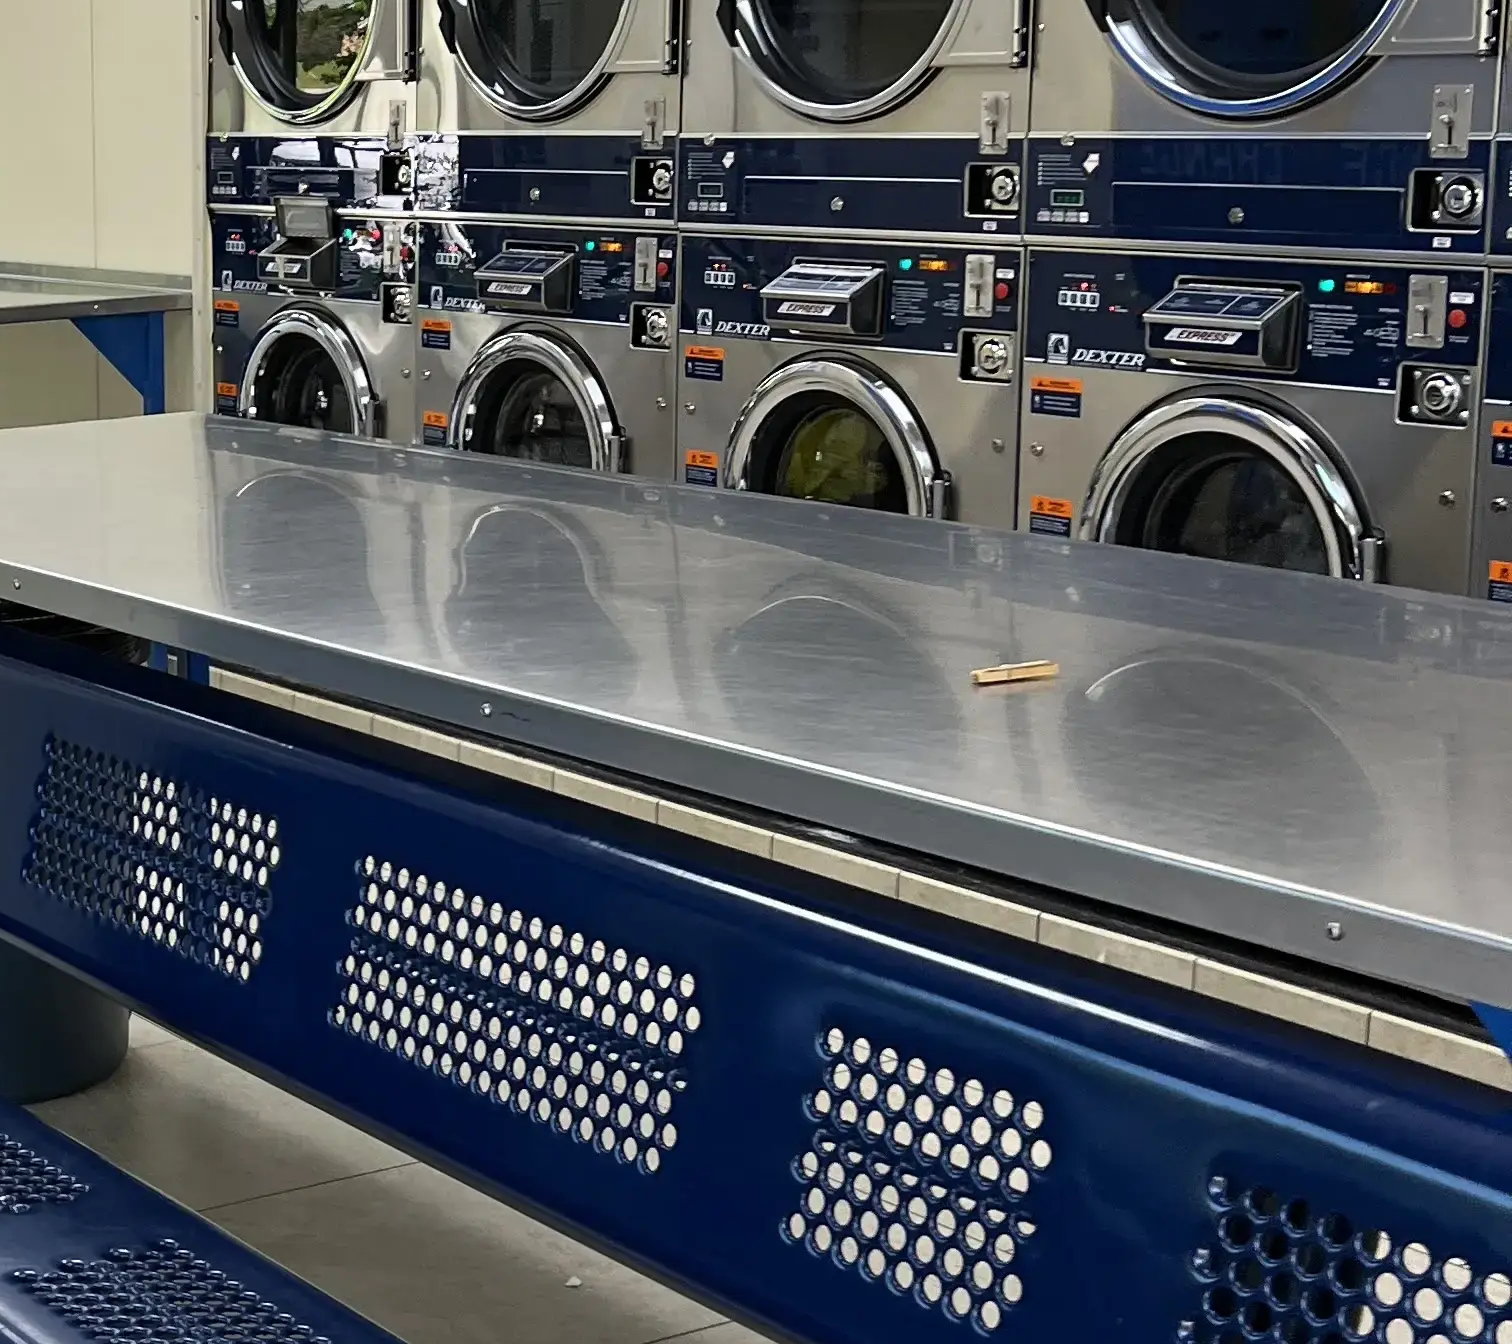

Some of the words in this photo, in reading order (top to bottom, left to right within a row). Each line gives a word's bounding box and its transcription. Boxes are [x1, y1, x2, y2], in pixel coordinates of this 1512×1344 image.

[233, 280, 268, 291] DEXTER
[786, 303, 826, 314] EXPRESS
[714, 321, 770, 336] DEXTER
[1176, 329, 1230, 342] EXPRESS
[1071, 349, 1146, 366] DEXTER
